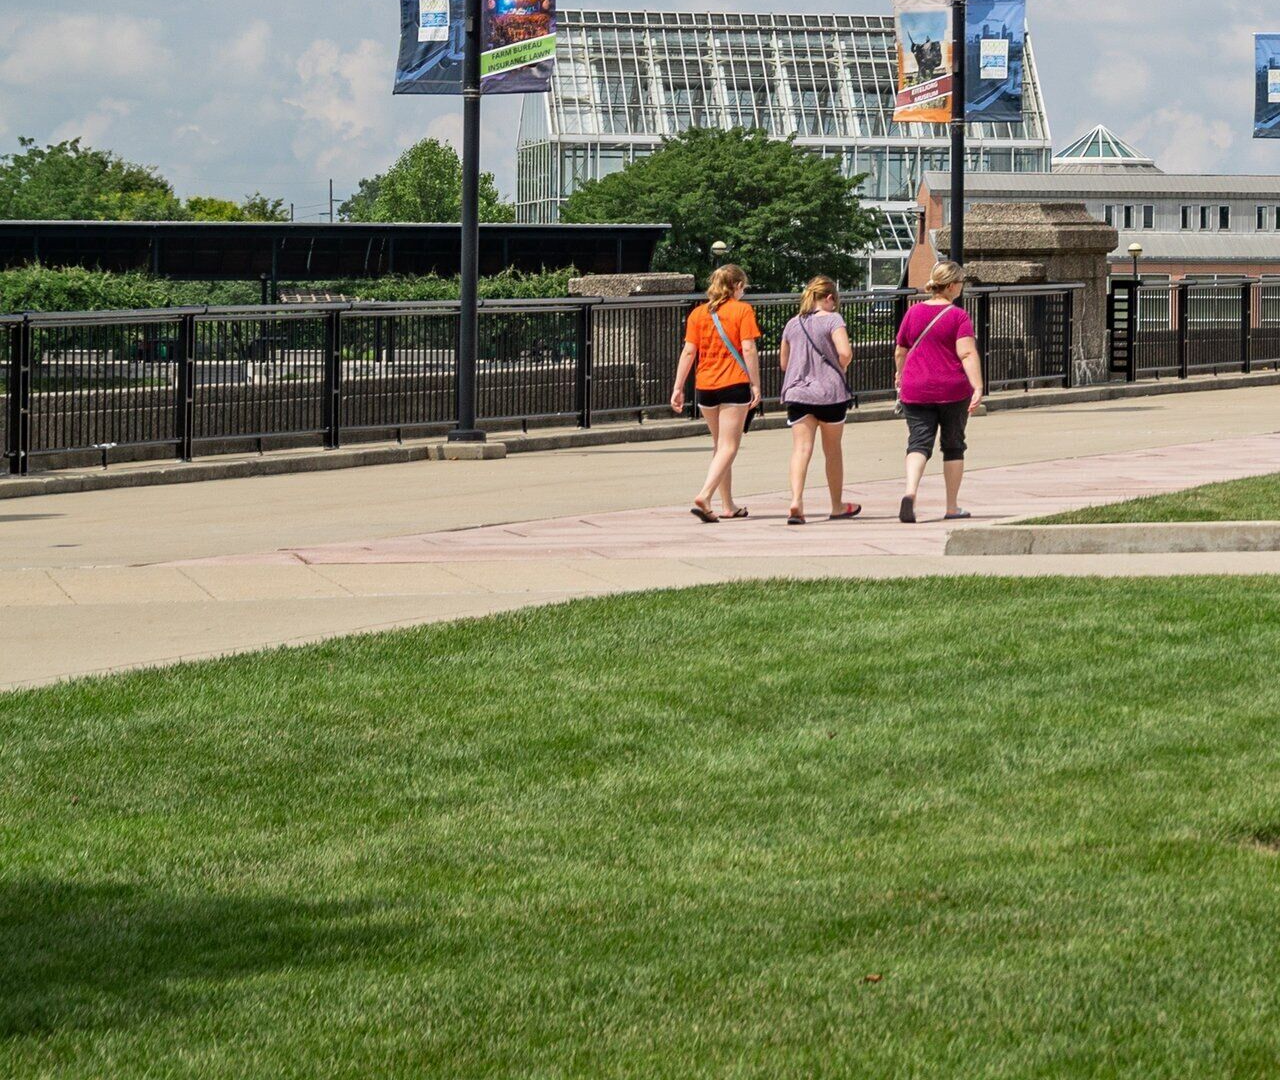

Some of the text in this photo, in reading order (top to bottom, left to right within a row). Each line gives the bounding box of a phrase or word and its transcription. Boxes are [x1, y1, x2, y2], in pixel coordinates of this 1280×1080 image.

[488, 49, 551, 72] INSURANCE LAWN
[491, 41, 543, 60] FARM BUREAU
